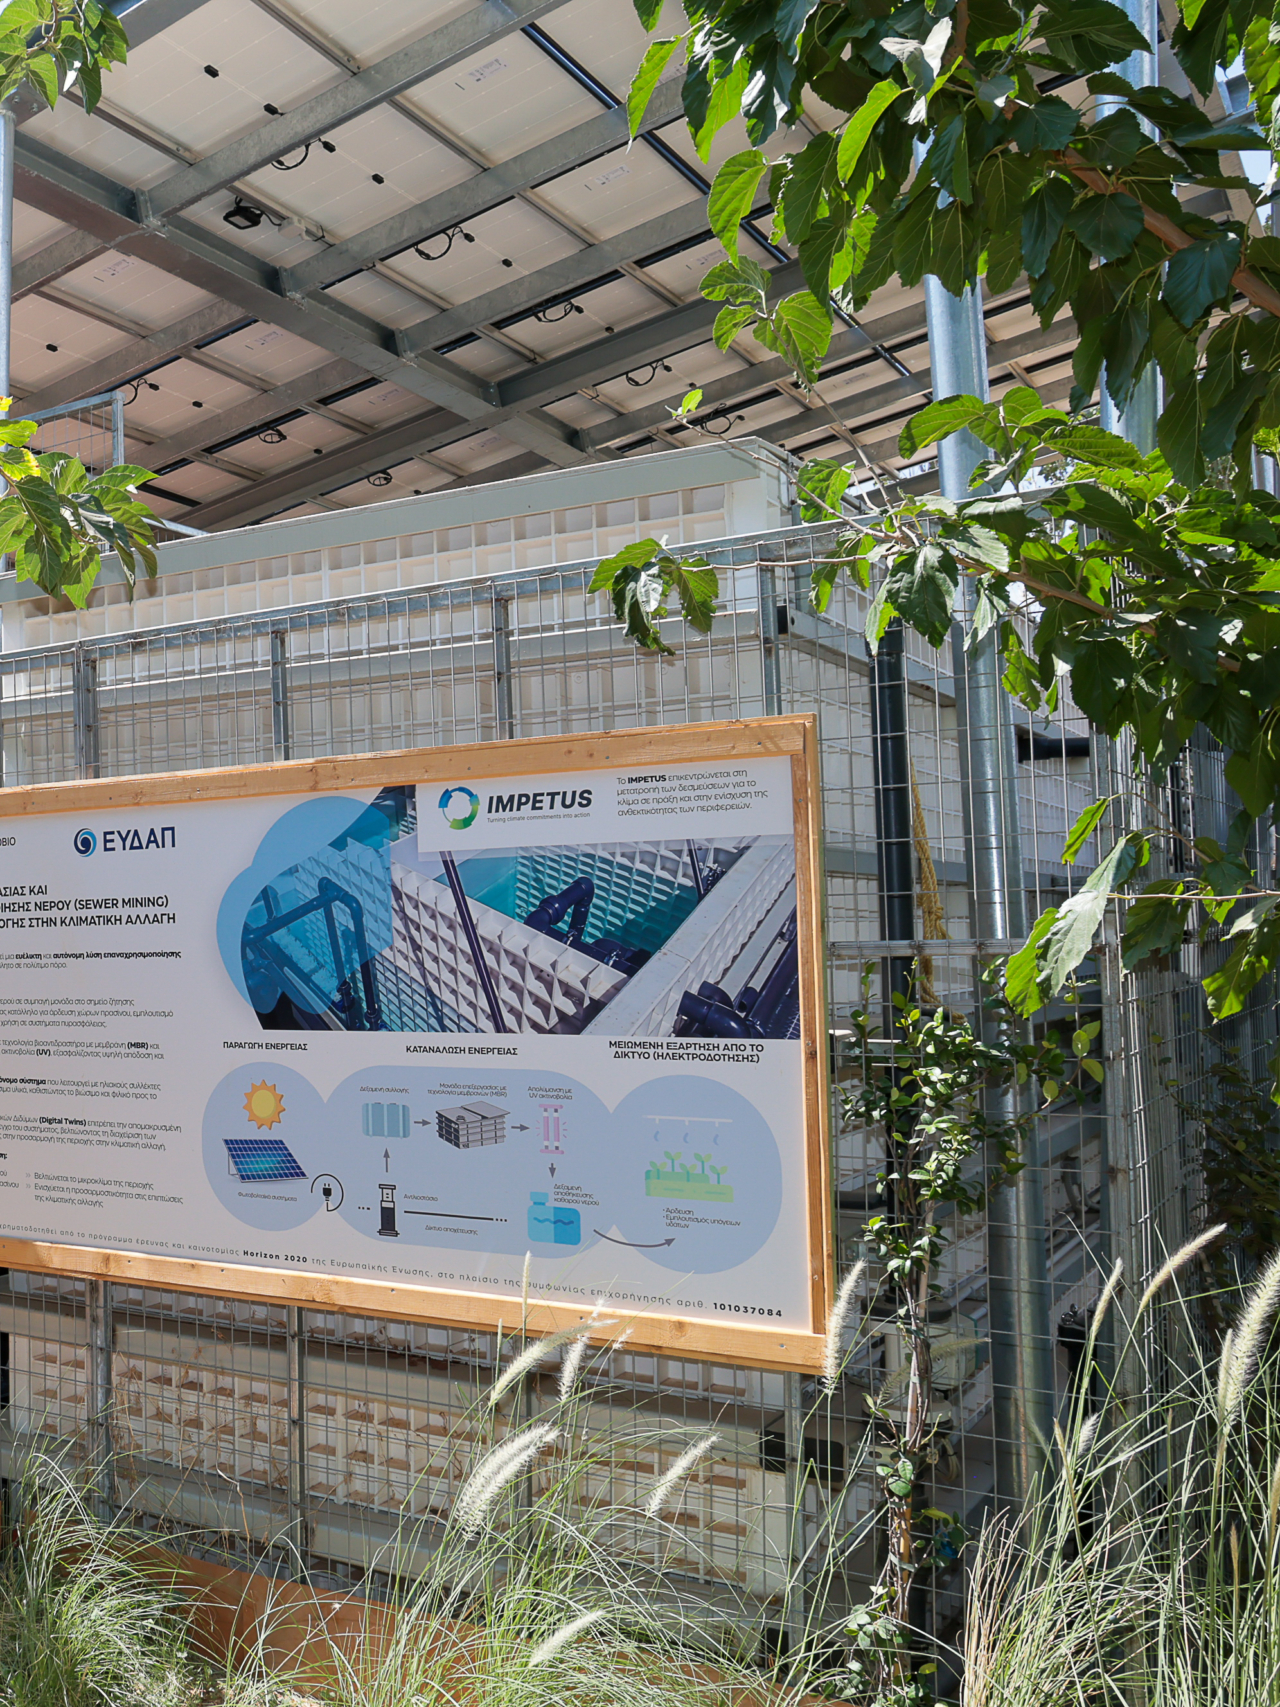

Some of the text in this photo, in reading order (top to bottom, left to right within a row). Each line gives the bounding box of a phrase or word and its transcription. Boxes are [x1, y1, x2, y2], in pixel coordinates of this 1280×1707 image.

[628, 775, 666, 783] IMPETUS
[668, 771, 731, 782] επικεντρώνεται
[732, 769, 747, 778] στη
[617, 785, 659, 796] μετατροπή
[678, 781, 730, 792] δεσμεύσεων
[731, 781, 745, 789] για
[487, 789, 592, 813] IMPETUS
[652, 796, 678, 806] πράξη
[694, 794, 712, 804] στην
[714, 791, 752, 801] ενίσχυση
[754, 790, 768, 798] της
[697, 801, 752, 812] περιφερειών.
[103, 826, 175, 852] ΕΥΔΑΠ
[29, 885, 47, 895] ΚΑΙ
[34, 900, 71, 912] ΝΕΡΟΥ
[74, 898, 118, 911] (SEWER
[122, 895, 168, 908] MINING)
[28, 917, 57, 928] ΣΤΗΝ
[60, 915, 122, 926] ΚΛΙΜΑΤΙΚΗ
[125, 913, 176, 925] ΑΛΛΑΓΗ
[128, 1042, 148, 1050] (MBR)
[406, 1046, 518, 1055] ΚΑΤΑΝΑΛΩΣΗ ΕΝΕΡΓΕΙΑΣ
[609, 1041, 764, 1052] ΜΕΙΩΜΕΝΗ ΕΞΑΡΤΗΣΗ ΑΠΟ ΤΟ
[614, 1051, 760, 1063] ΔΙΚΤΥΟ (ΗΛΕΚΤΡΟΔΟΤΗΣΗΣ)
[64, 1118, 86, 1126] Twins)
[89, 1233, 132, 1243] πρόγραμμα
[243, 1250, 280, 1260] Horizon
[285, 1254, 307, 1263] 2020
[460, 1274, 498, 1284] πλαίσιο
[504, 1278, 520, 1288] της
[714, 1303, 782, 1317] 101037084
